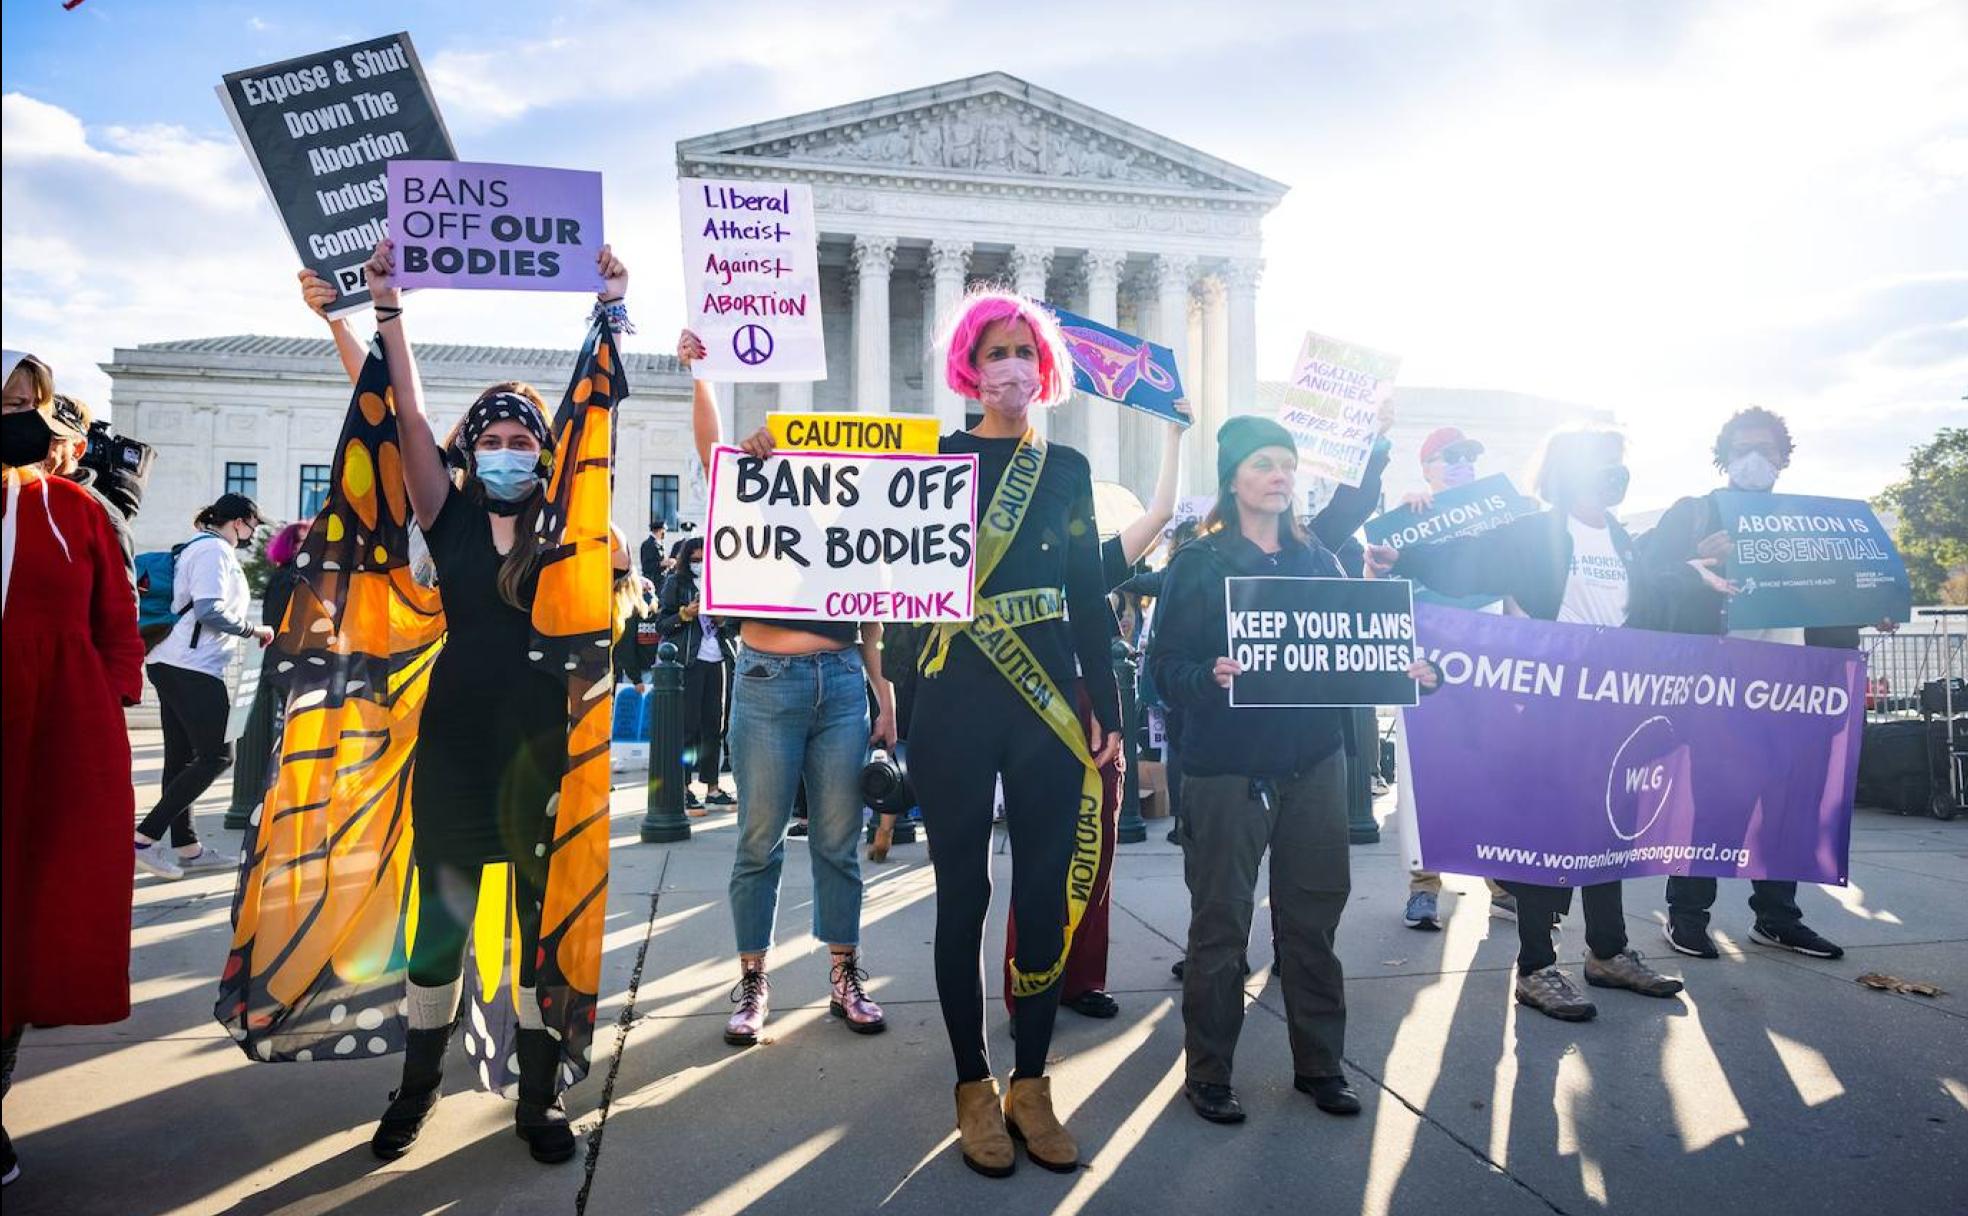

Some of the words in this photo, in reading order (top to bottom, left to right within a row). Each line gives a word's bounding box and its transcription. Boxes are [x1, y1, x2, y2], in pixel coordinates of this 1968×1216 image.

[240, 67, 331, 106] Expose
[334, 59, 352, 85] &
[352, 43, 409, 80] Shut
[283, 104, 354, 139] Down
[352, 90, 399, 121] The
[308, 130, 409, 176] Abortion
[404, 177, 509, 208] BANS
[403, 211, 481, 240] OFF
[490, 214, 582, 245] OUR
[703, 217, 791, 243] Atheist
[403, 245, 560, 277] BODIES
[704, 252, 793, 285] Against
[1297, 373, 1376, 405] ANOTHER
[786, 420, 903, 449] CAUTION
[736, 457, 860, 508] BANS
[888, 463, 972, 510] OFF
[988, 440, 1042, 534] CAUTION
[1381, 501, 1483, 549] ABORTION
[1484, 494, 1506, 512] IS
[1737, 514, 1846, 534] ABORTION
[1848, 517, 1870, 534] IS
[714, 523, 811, 568] OUR
[826, 522, 972, 569] BODIES
[1737, 537, 1889, 565] ESSENTIAL
[825, 590, 961, 620] CODEPINK
[1230, 611, 1288, 639] KEEP
[1292, 611, 1352, 640] YOUR
[1356, 612, 1412, 640] LAWS
[969, 612, 1054, 712] CAUTION
[1237, 643, 1278, 672] OFF
[1283, 643, 1330, 672] OUR
[1335, 643, 1411, 672] BODIES
[1576, 665, 1694, 706] LAWYERS
[1694, 674, 1736, 708] ON
[1744, 679, 1849, 716] GUARD
[1624, 764, 1664, 794] WLG
[1475, 843, 1750, 870] www.womenlawyersonguard.org
